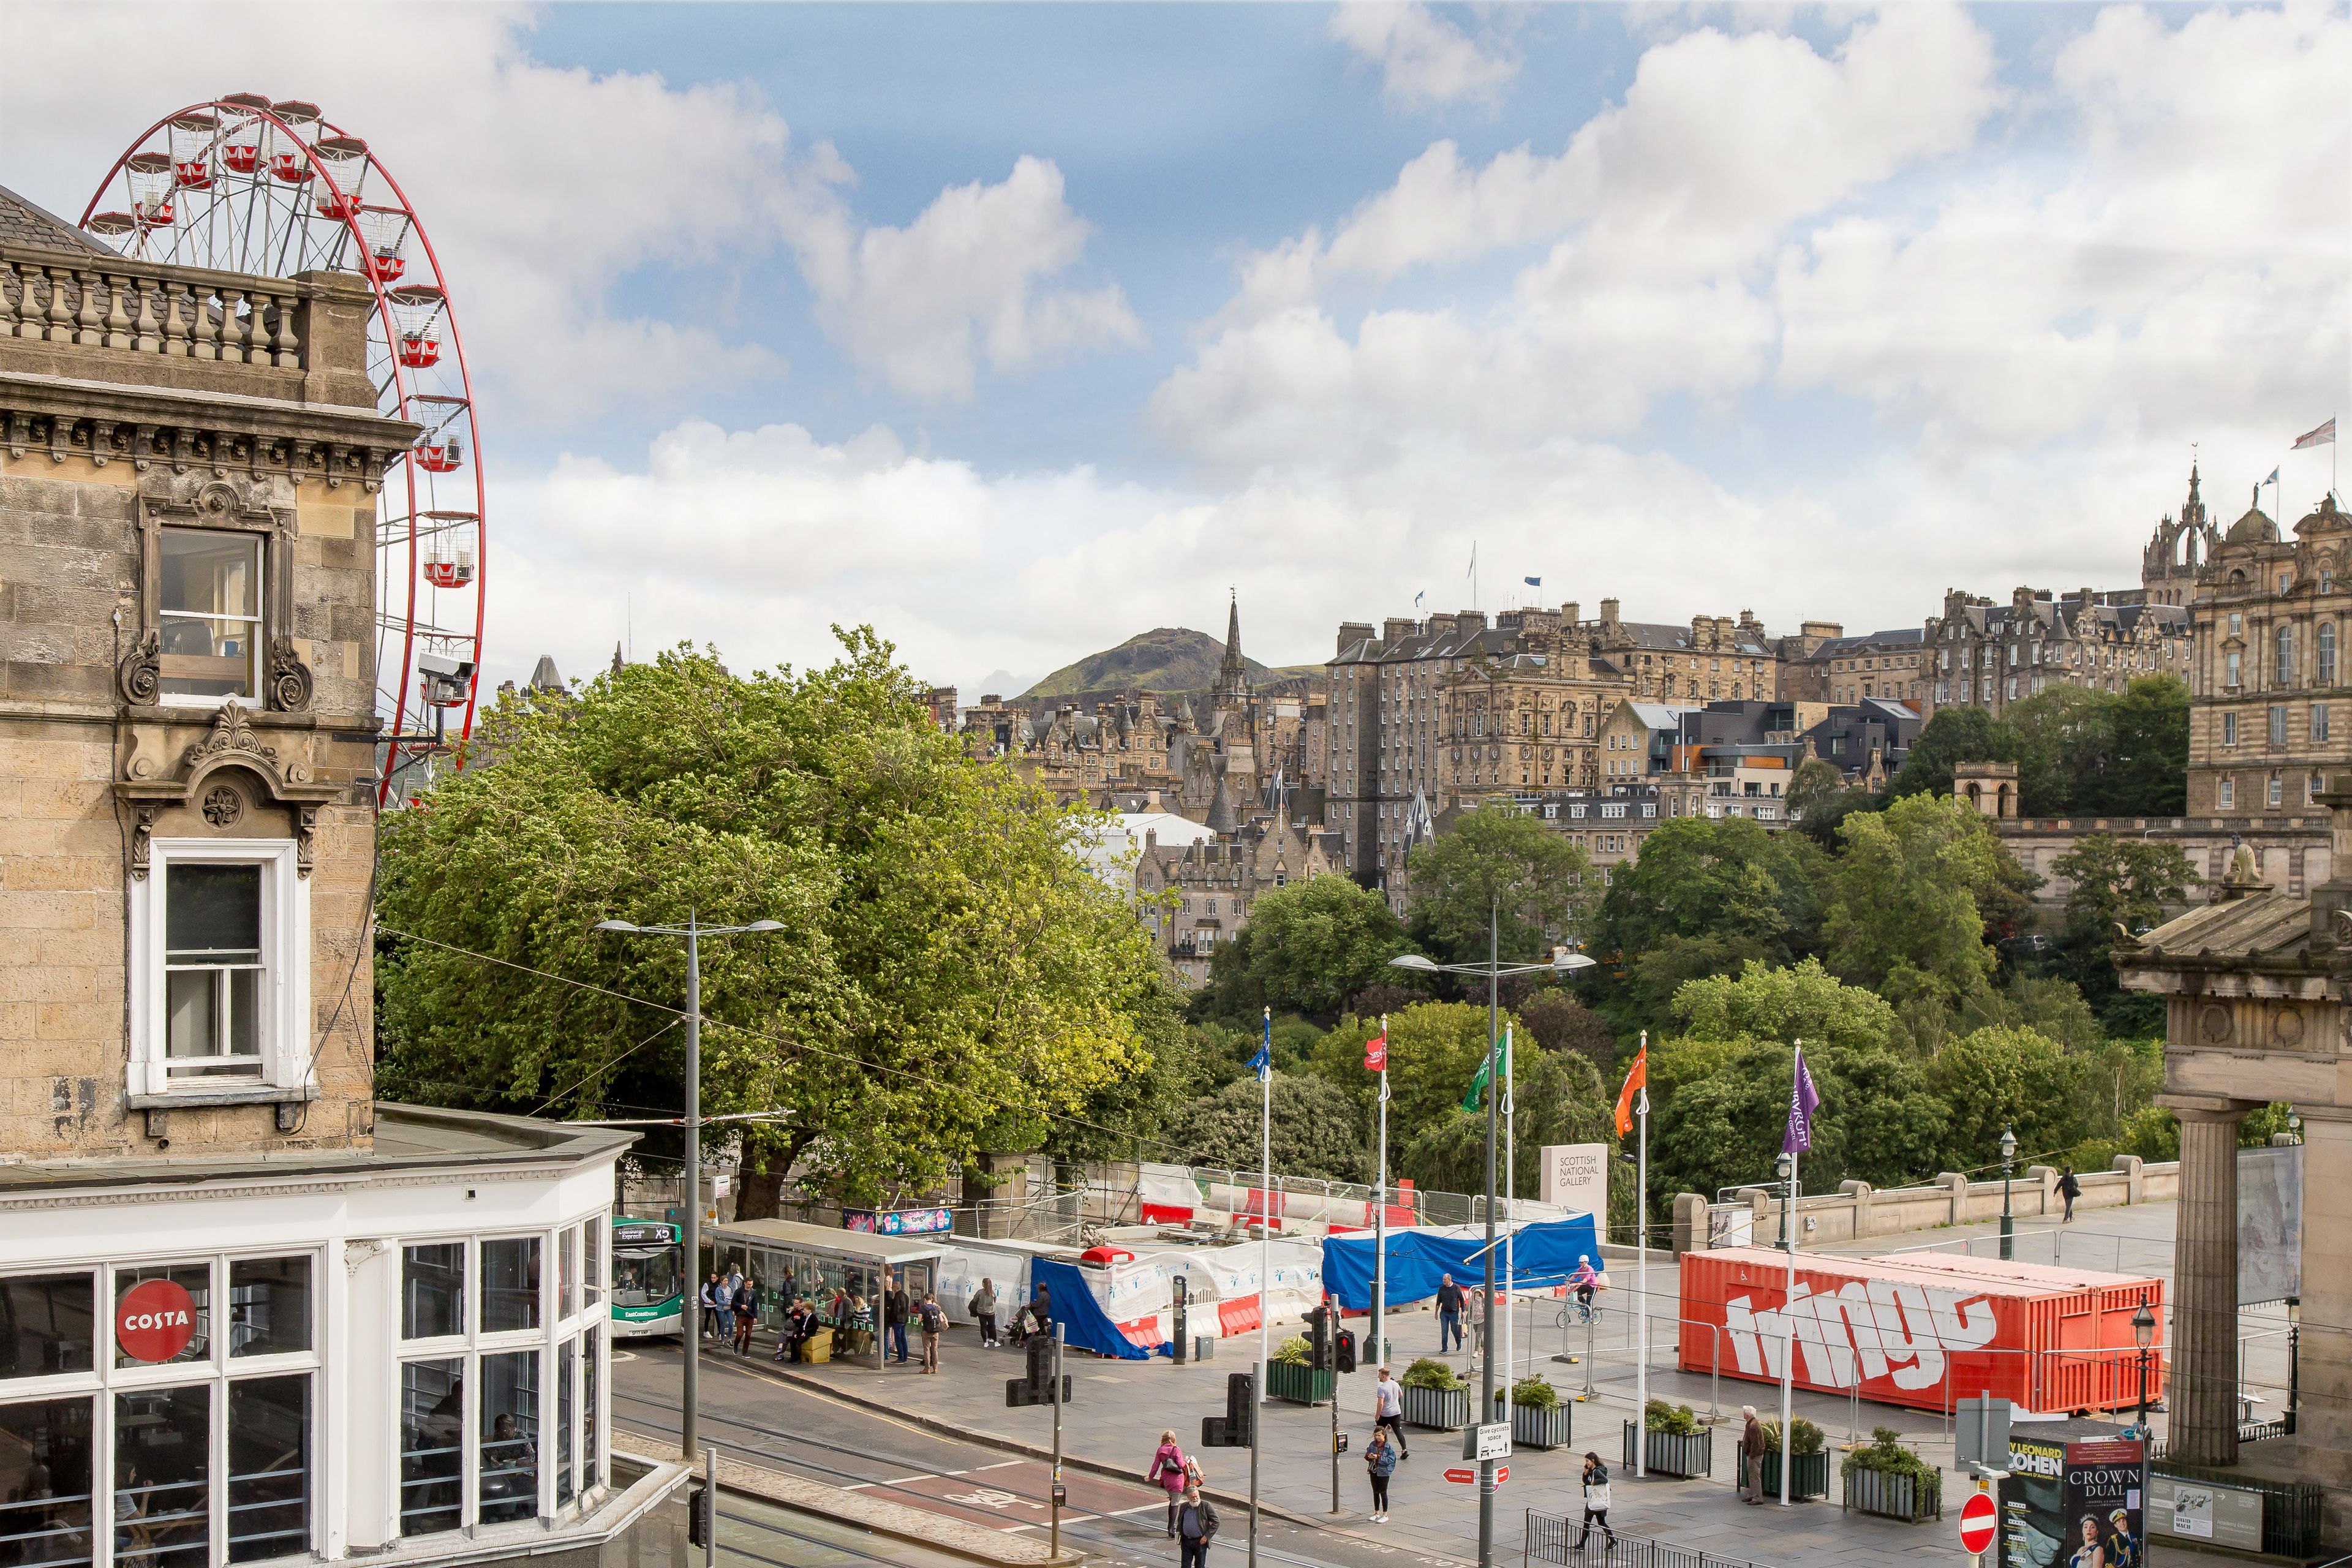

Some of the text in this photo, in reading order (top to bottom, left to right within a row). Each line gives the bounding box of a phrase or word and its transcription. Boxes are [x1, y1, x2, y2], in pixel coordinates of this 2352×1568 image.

[1559, 1155, 1596, 1166] SCOTTISH
[1559, 1166, 1599, 1177] NATIONAL
[1559, 1176, 1592, 1187] GALLERY
[911, 1214, 926, 1223] Tango
[655, 1227, 670, 1239] X5
[124, 1310, 189, 1332] COSTA
[1491, 1425, 1510, 1434] cyclists
[2018, 1443, 2063, 1459] LEONARD
[2008, 1452, 2062, 1476] COHEN
[2070, 1469, 2139, 1485] CROWN
[2086, 1485, 2126, 1497] DUAL
